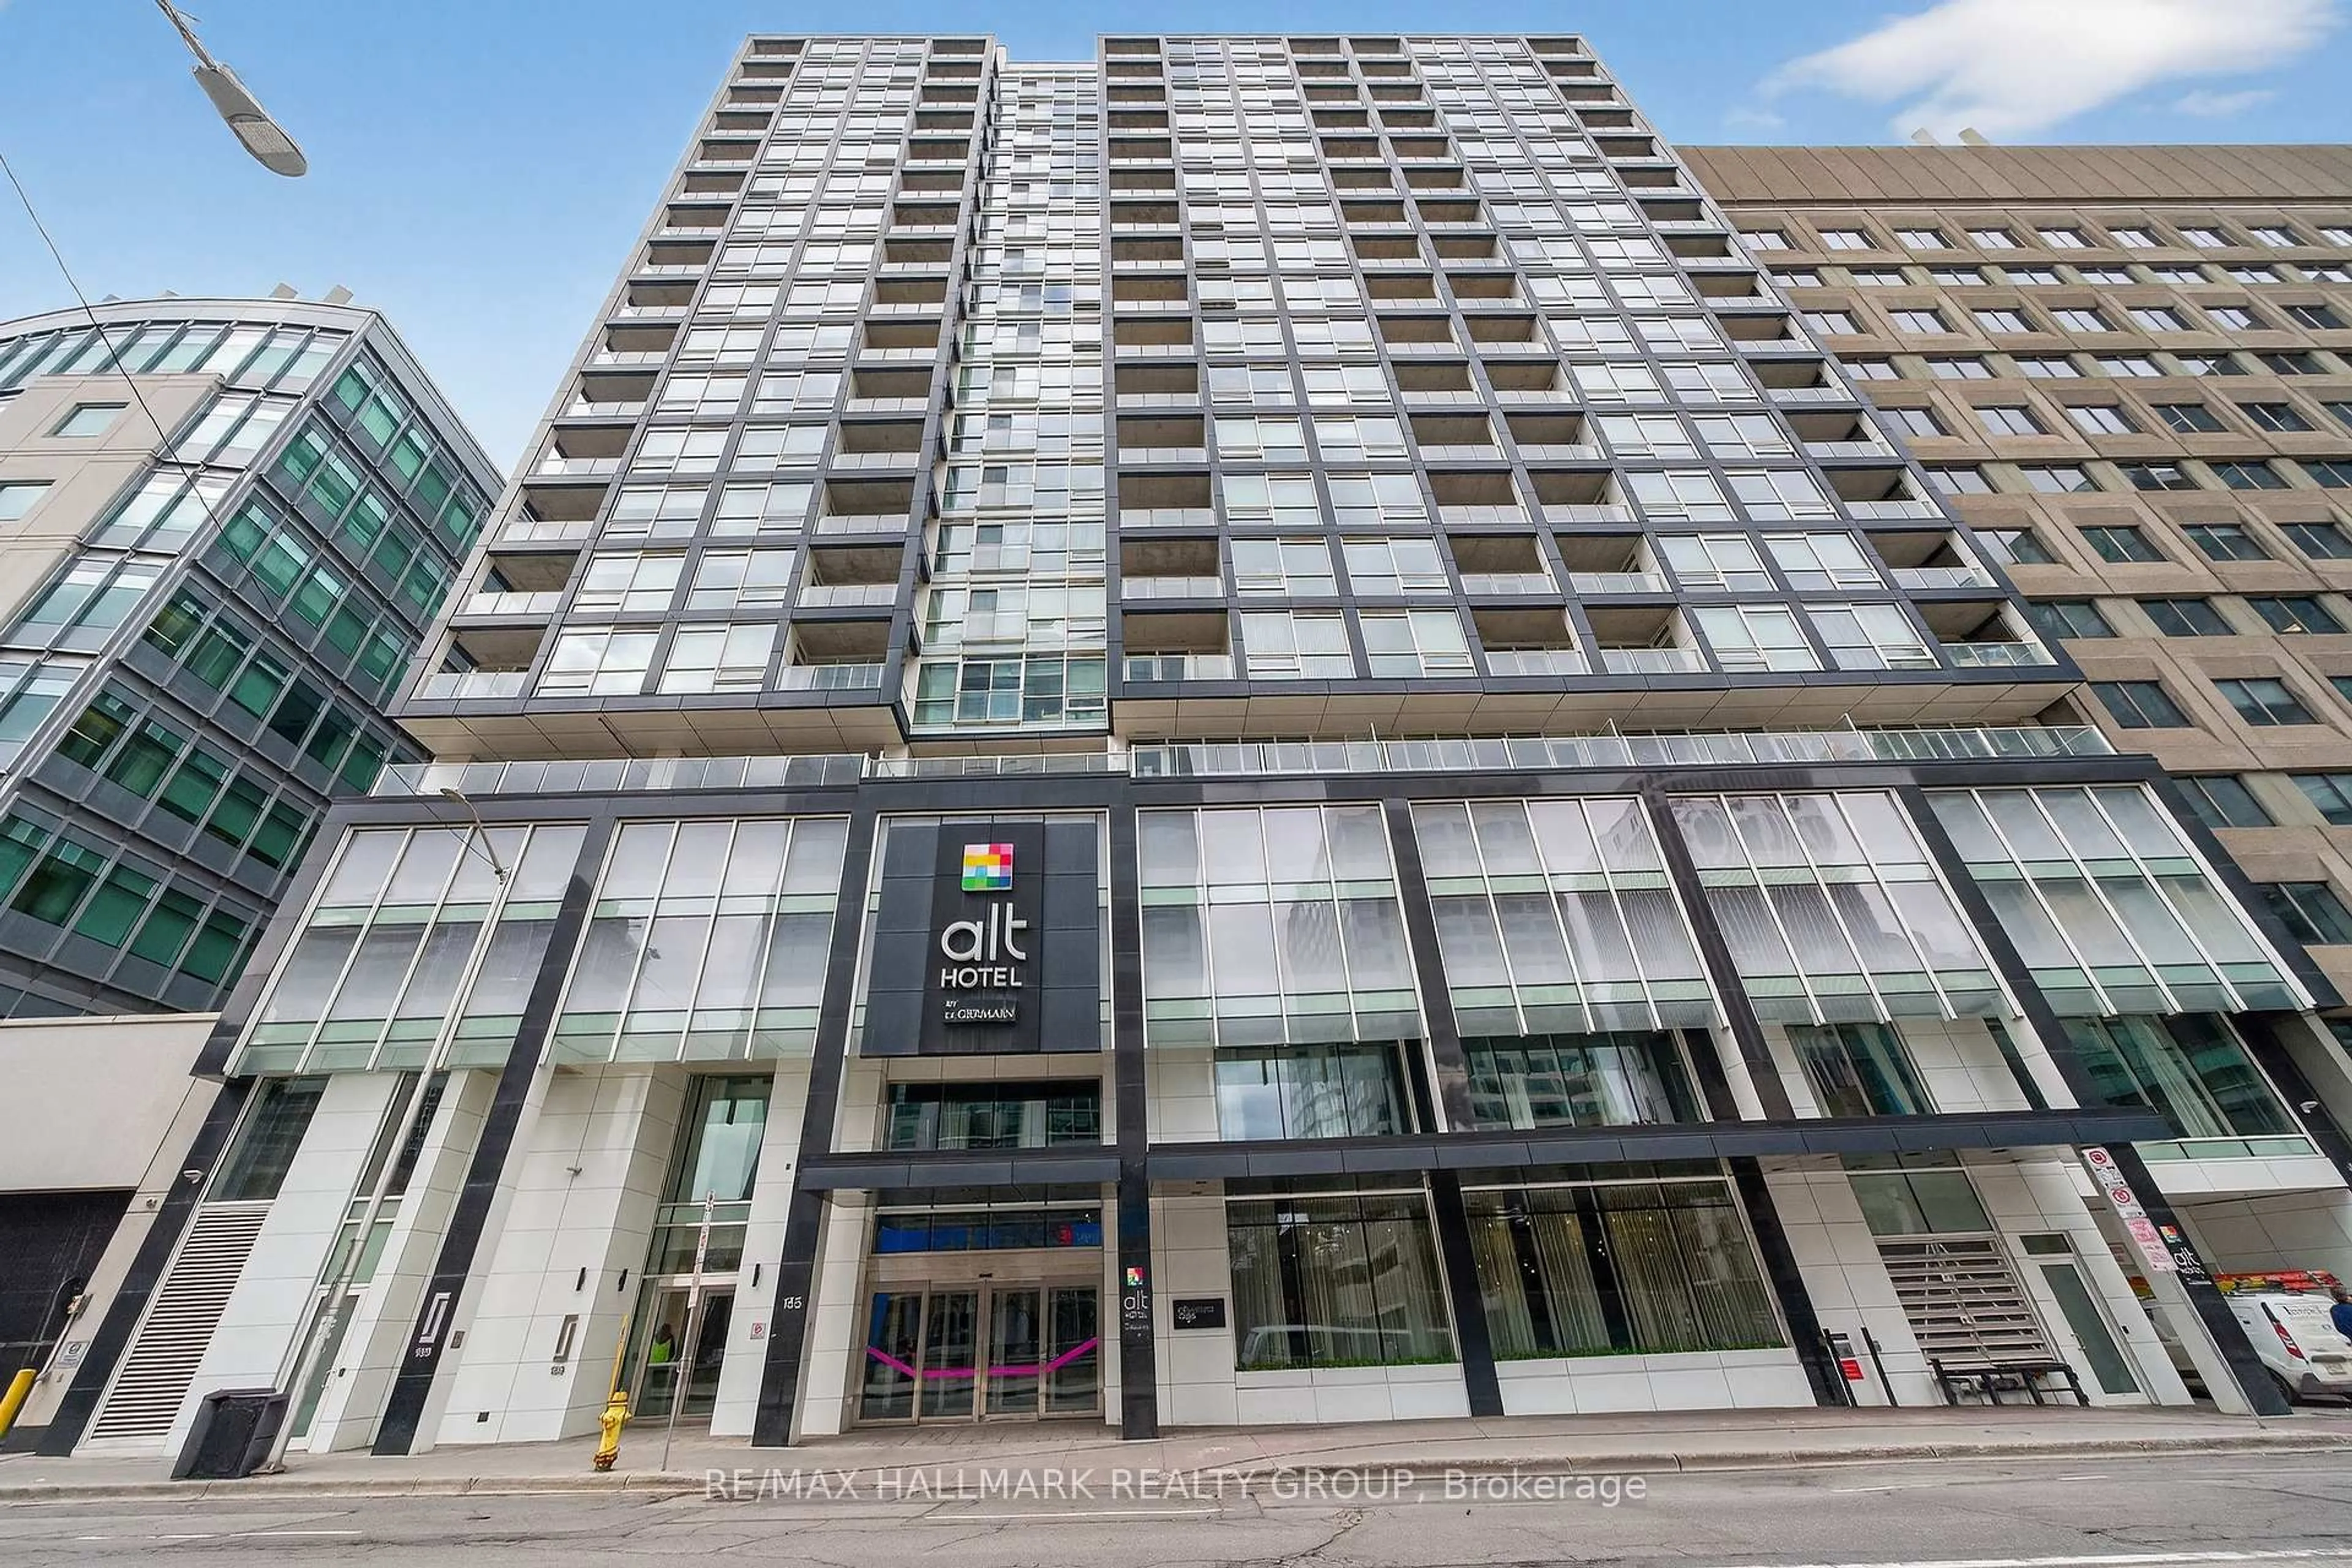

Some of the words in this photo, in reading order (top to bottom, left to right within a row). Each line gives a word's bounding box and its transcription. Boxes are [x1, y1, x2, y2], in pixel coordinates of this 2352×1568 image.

[941, 902, 1027, 962] alt
[940, 967, 1022, 988] HOTEL
[2174, 1246, 2201, 1266] alt
[1124, 1289, 1148, 1310] alt
